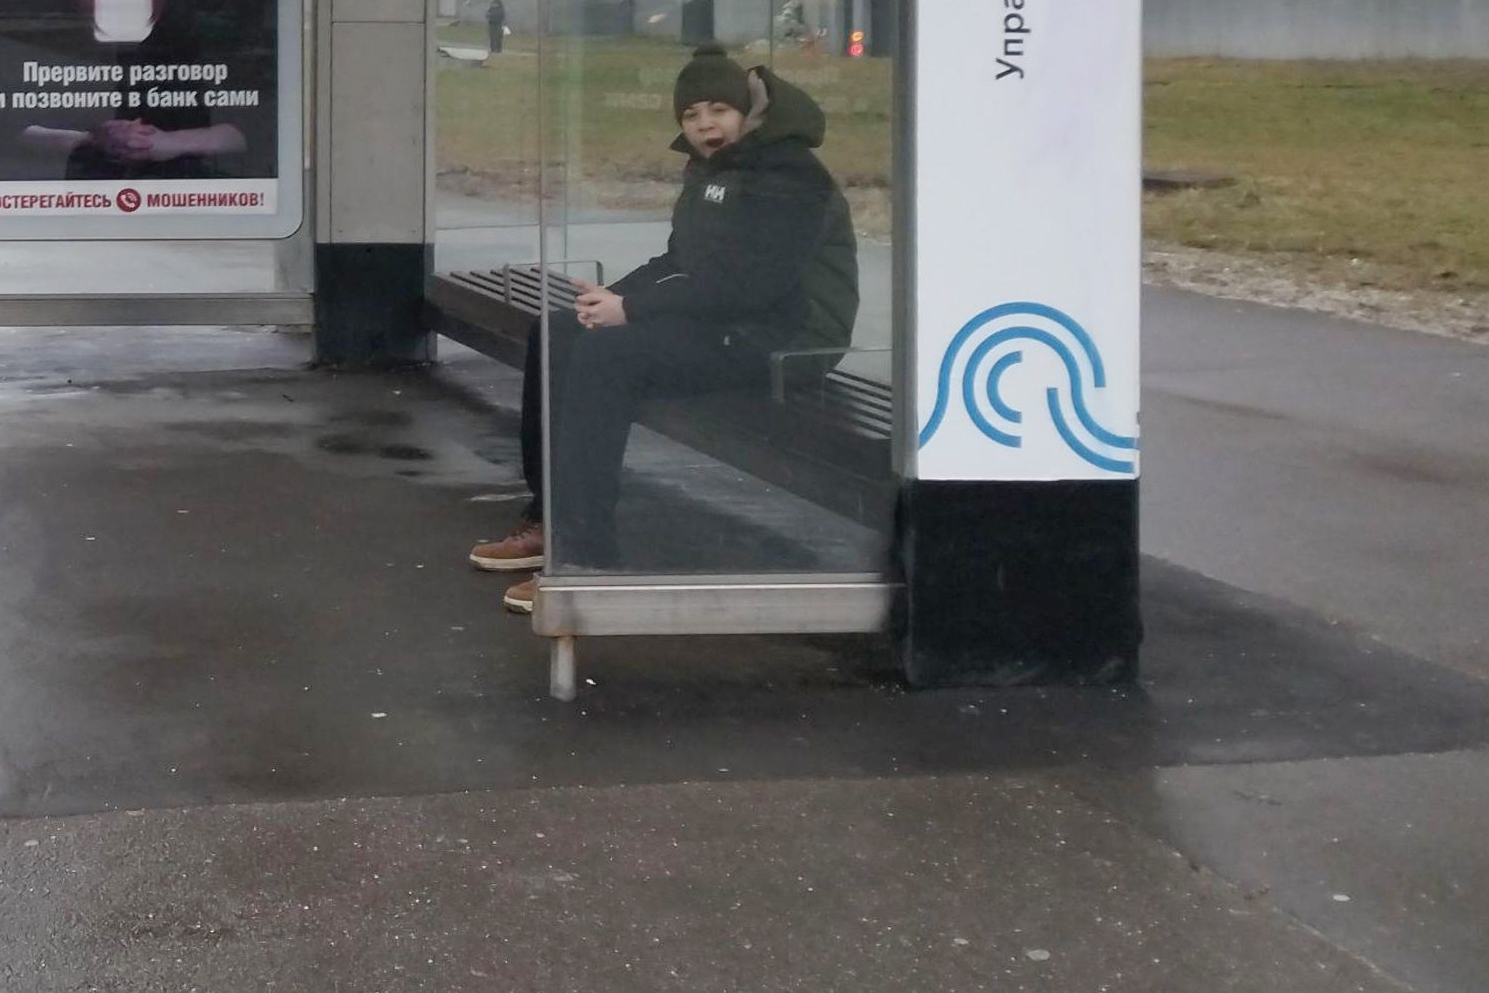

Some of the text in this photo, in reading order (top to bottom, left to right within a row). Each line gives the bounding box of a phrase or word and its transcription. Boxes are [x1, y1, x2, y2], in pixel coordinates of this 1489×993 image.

[23, 61, 228, 86] Прервите разговор
[12, 91, 123, 109] позвоните
[128, 91, 141, 108] в
[146, 87, 198, 108] банк
[204, 90, 259, 107] сами
[146, 192, 265, 208] МОШЕННИКОВ!
